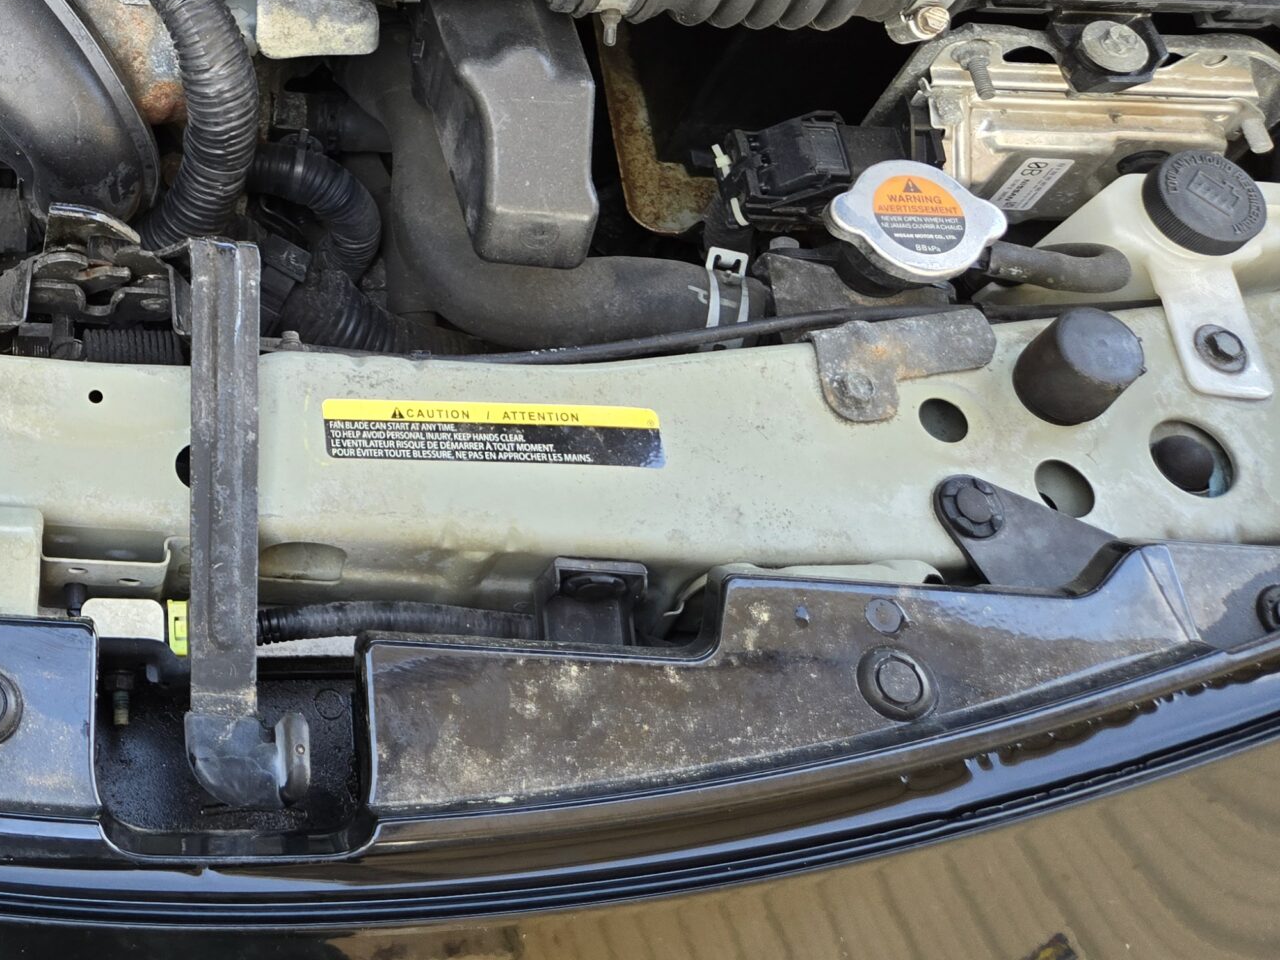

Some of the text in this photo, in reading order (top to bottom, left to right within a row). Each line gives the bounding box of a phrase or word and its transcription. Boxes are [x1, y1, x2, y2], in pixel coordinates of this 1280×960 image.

[1004, 178, 1030, 201] NISSAN
[887, 194, 942, 204] WARNING
[878, 204, 958, 214] AVERTISSEMENT
[406, 408, 470, 419] CAUTION
[502, 410, 579, 422] ATTENTION
[329, 420, 344, 429] FAN
[345, 421, 369, 430] BLADE
[370, 421, 386, 430] CAN
[387, 422, 410, 431] START
[410, 422, 419, 431] AT
[421, 423, 436, 431] ANY
[330, 430, 526, 442] TO HELP AVOID PERSONAL INJURY, KEEP HANDS CLEAR.
[331, 439, 340, 447] LE
[342, 439, 395, 448] VENTILATEUR
[396, 440, 426, 449] RISQUE
[426, 441, 438, 449] DE
[440, 440, 484, 450] DÉMARRER
[492, 442, 515, 451] TOUT
[516, 443, 556, 452] MOMENT.
[332, 448, 355, 456] POUR
[356, 447, 384, 457] ÉVITER
[384, 449, 411, 457] TOUTE
[412, 449, 454, 459] BLESSURE,
[455, 451, 467, 459] NE
[468, 451, 484, 459] PAS
[498, 452, 548, 461] APPROCHER
[548, 453, 563, 461] LES
[563, 453, 594, 462] MAINS.
